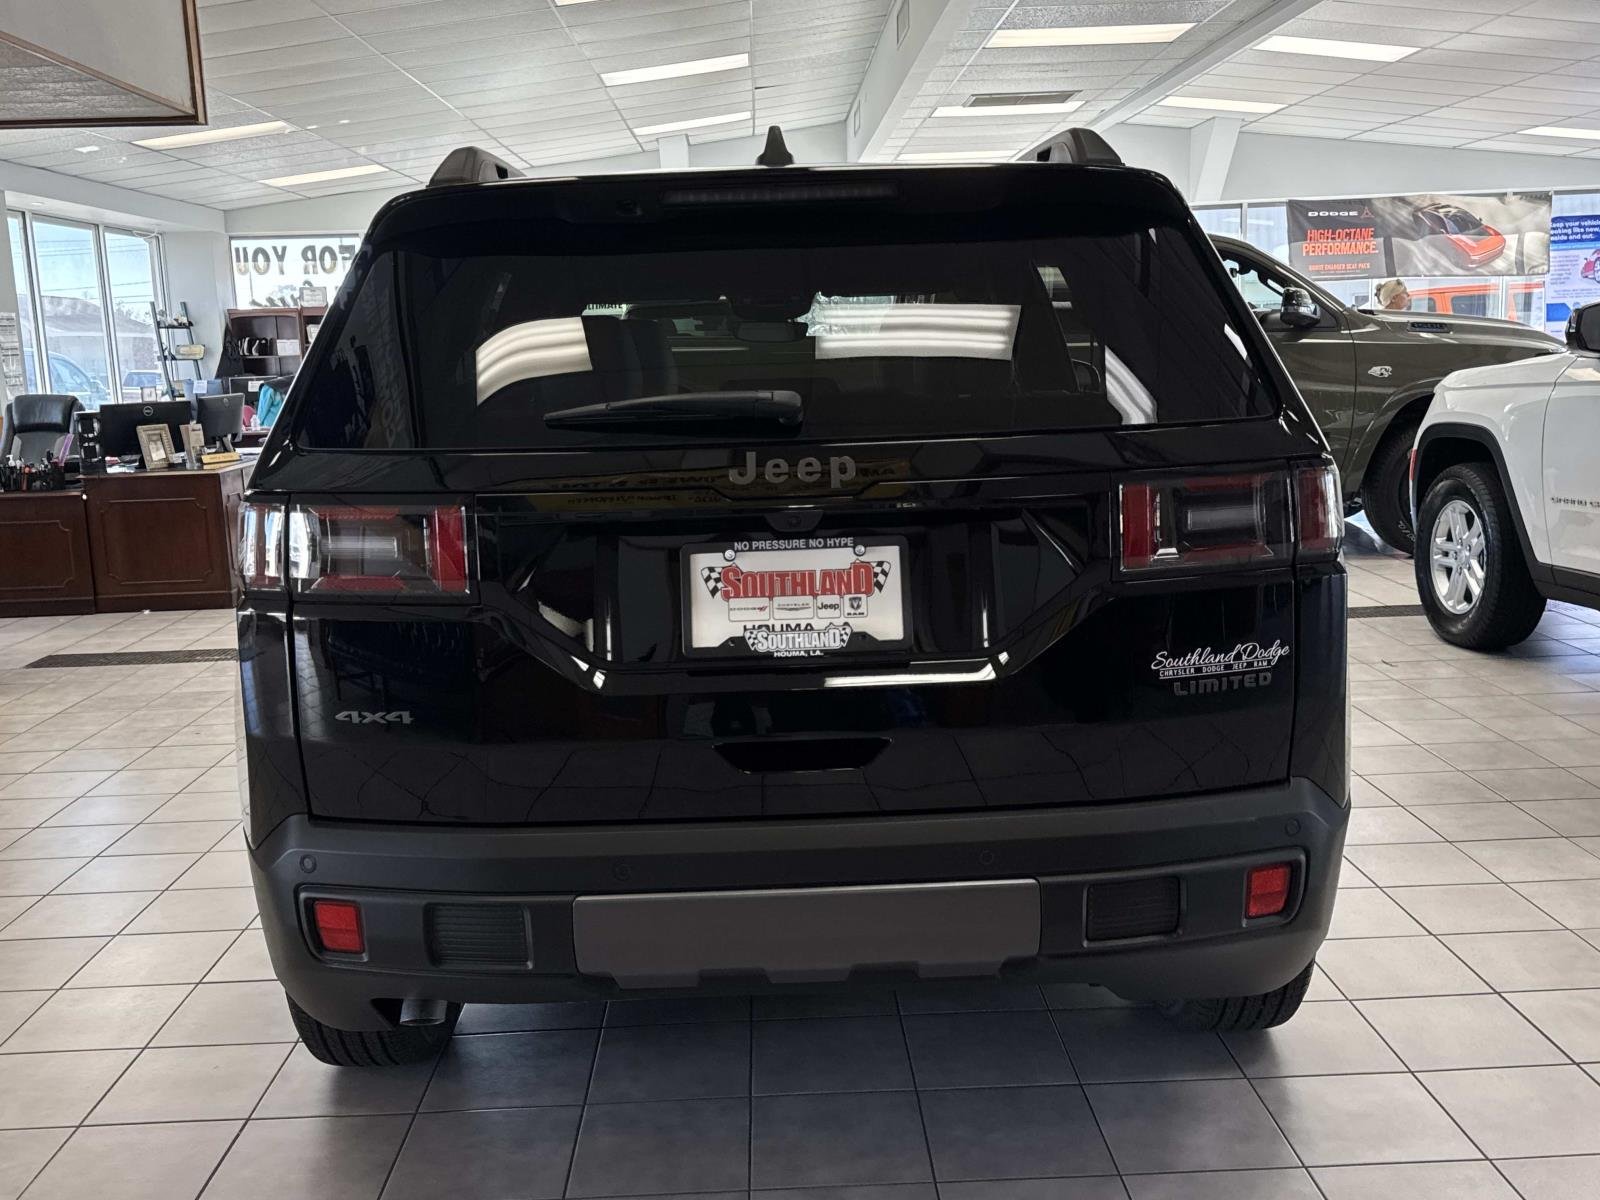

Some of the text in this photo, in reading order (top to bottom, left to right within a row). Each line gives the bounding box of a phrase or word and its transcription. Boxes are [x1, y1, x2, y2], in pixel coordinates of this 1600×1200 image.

[1306, 227, 1375, 242] HIGH-OCTANE
[1302, 241, 1379, 256] PERFORMANCE.
[728, 451, 857, 489] Jeep
[734, 537, 854, 551] NO PRESSURE NO HYPE
[721, 563, 874, 598] SOUTHLAND
[817, 602, 840, 611] Jeep
[757, 627, 842, 651] SOUTHLAND
[773, 650, 808, 658] HOUMA,
[1150, 639, 1290, 670] Southland Dodge
[1159, 660, 1268, 677] CHRYSLER DODGE JEEP RAM
[1173, 671, 1272, 696] LIMITED
